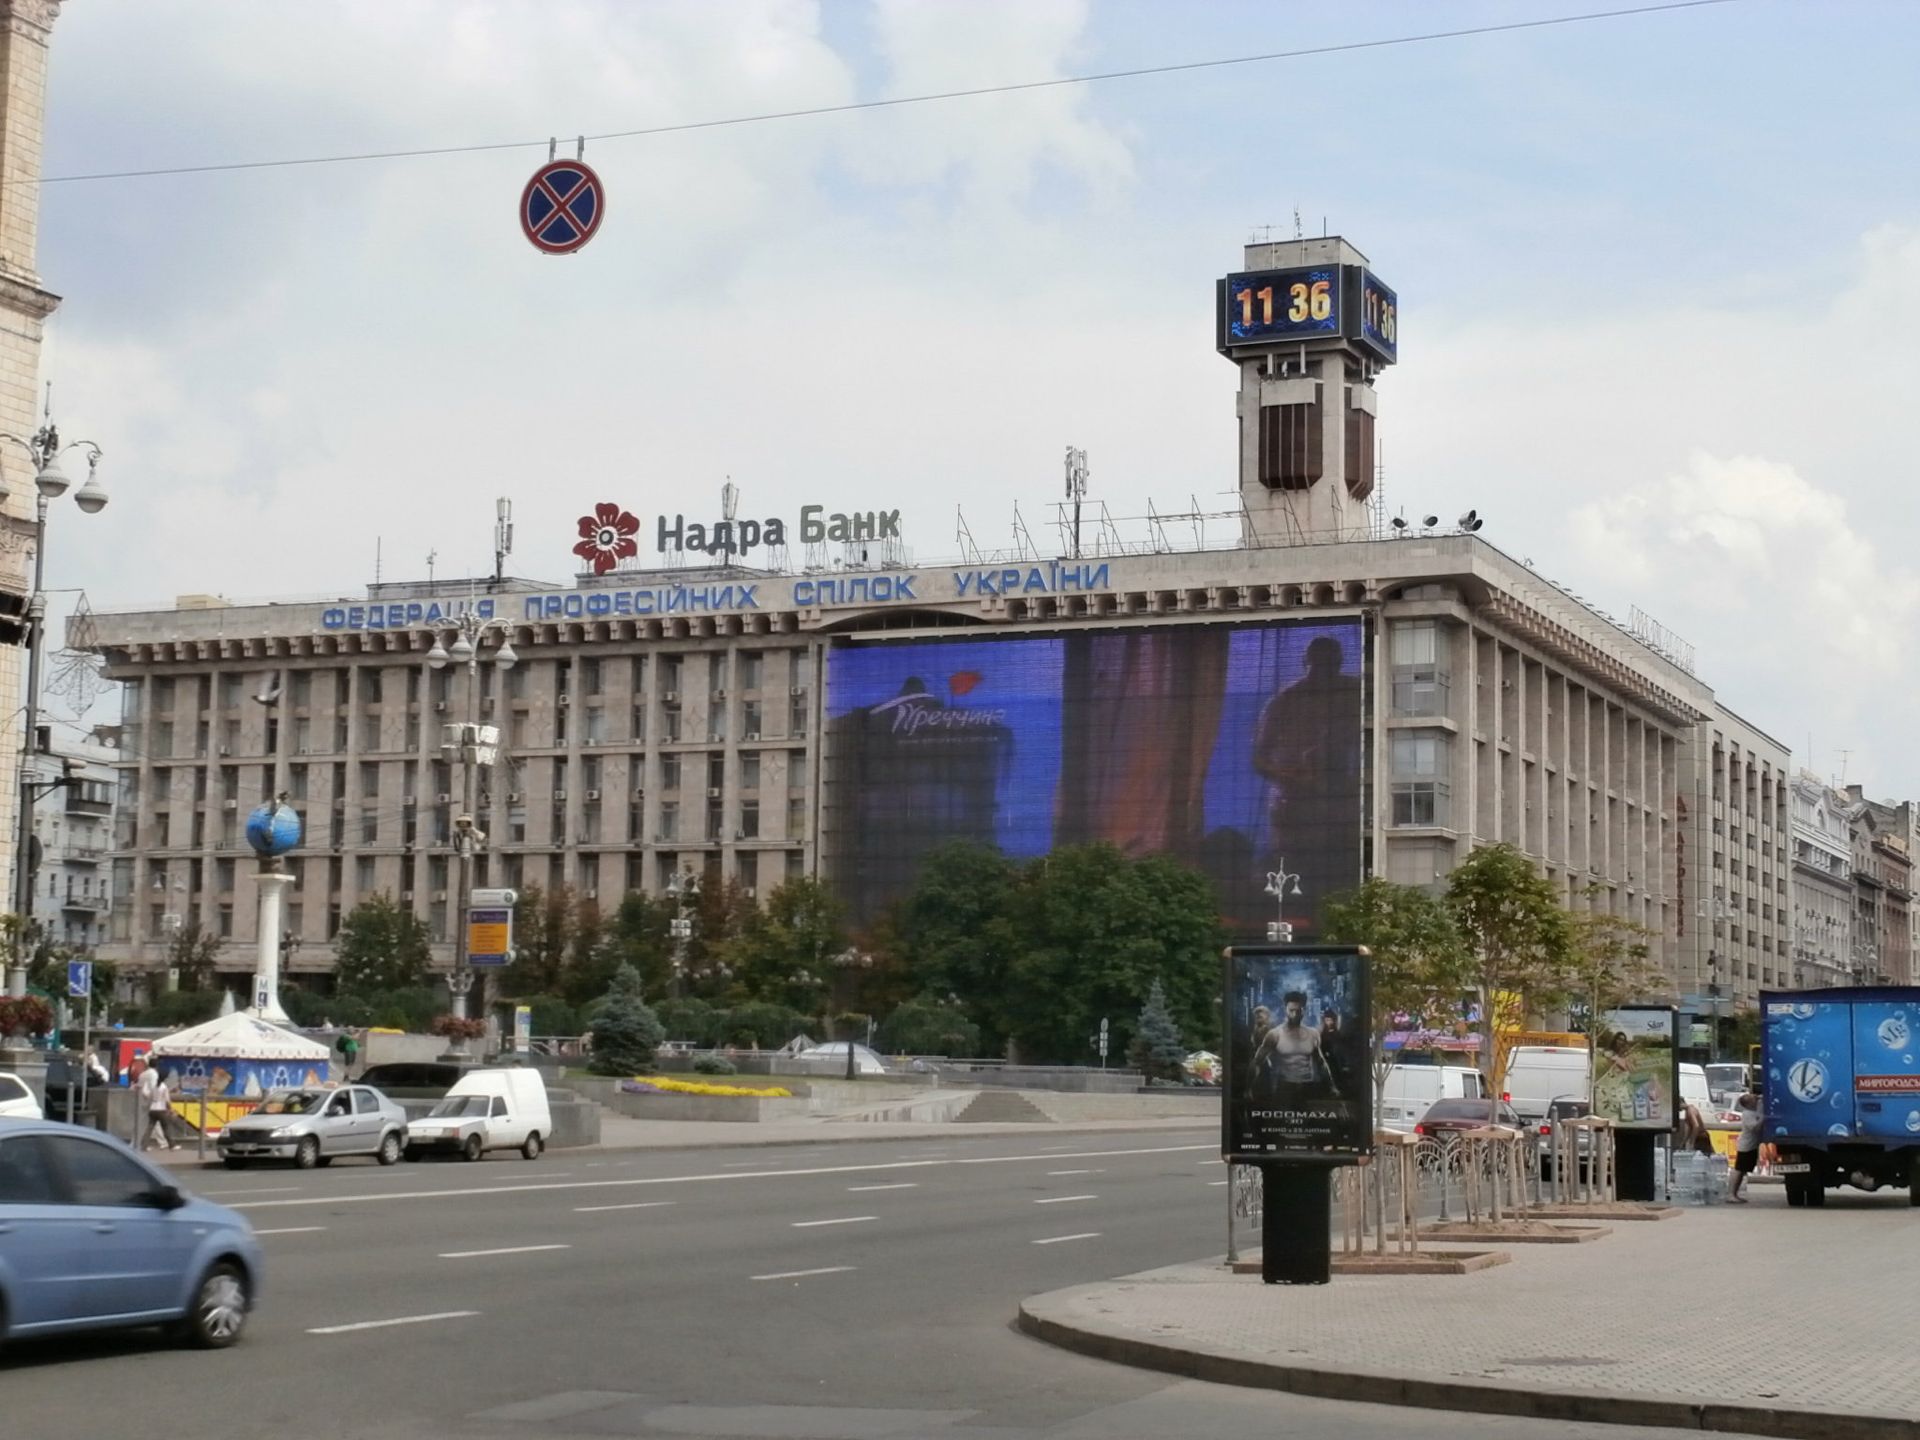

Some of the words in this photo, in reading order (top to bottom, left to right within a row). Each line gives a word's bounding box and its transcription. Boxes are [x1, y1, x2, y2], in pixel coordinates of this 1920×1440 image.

[1236, 286, 1272, 326] 11
[1288, 281, 1331, 322] 36
[657, 514, 785, 555] Надра
[800, 504, 900, 543] Банк
[525, 583, 759, 620] ПРОФЕСІЙНИХ
[793, 575, 917, 606] СПІЛОК
[954, 560, 1110, 597] УКРАЇНИ
[1251, 1110, 1337, 1118] РОСОМАХА
